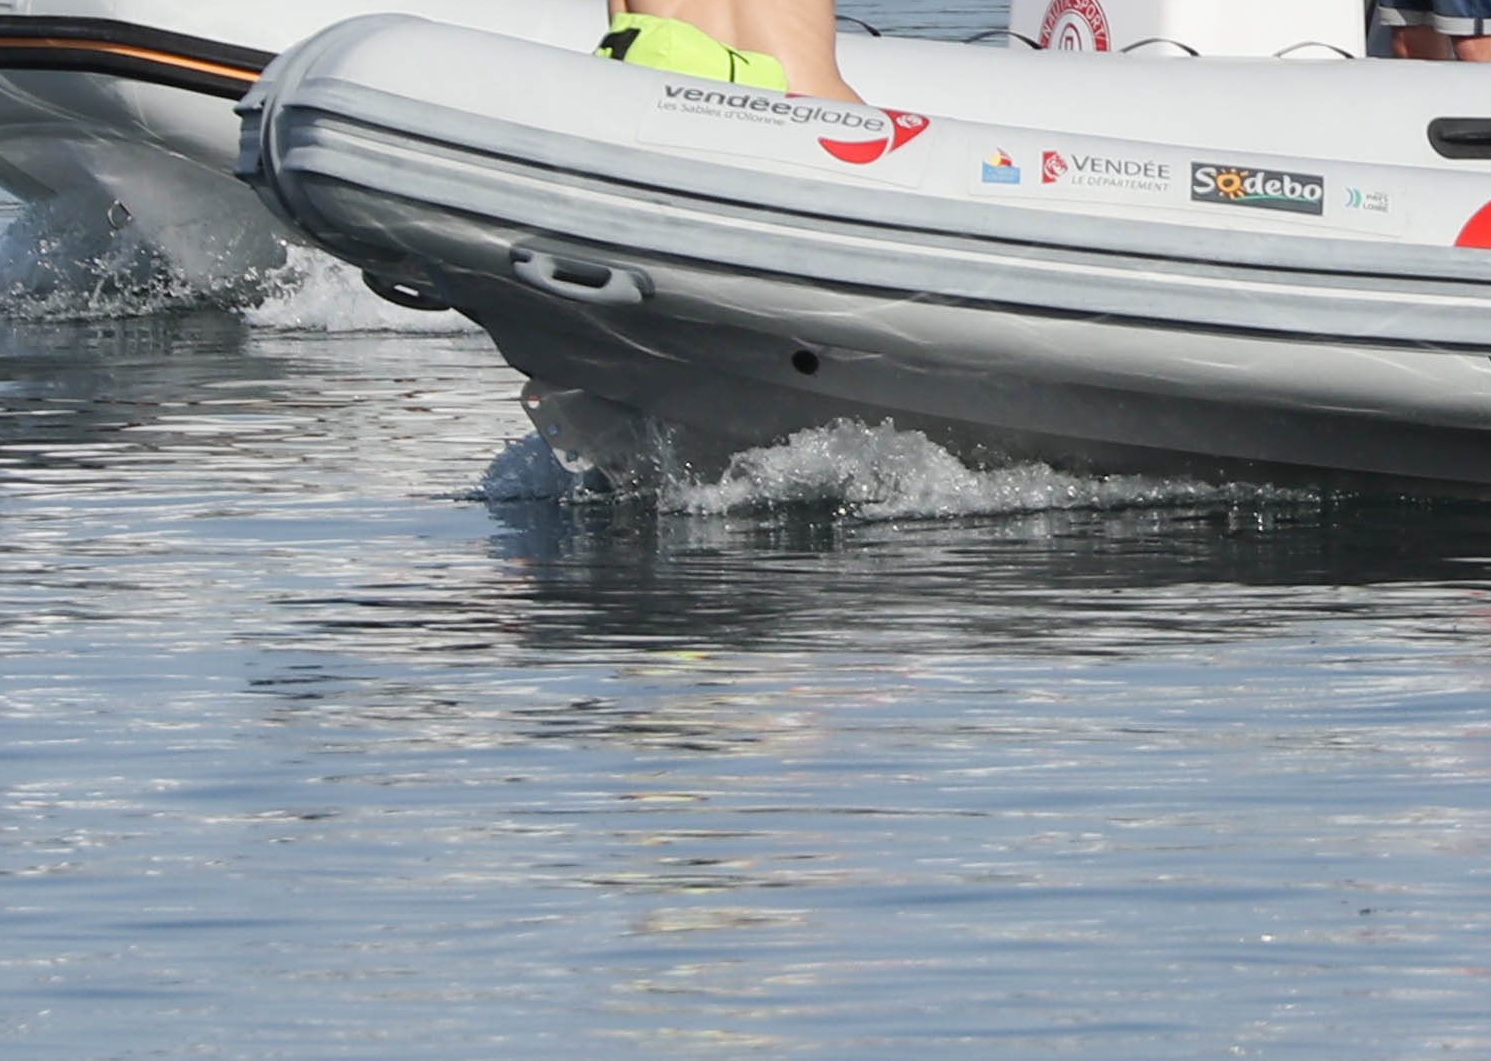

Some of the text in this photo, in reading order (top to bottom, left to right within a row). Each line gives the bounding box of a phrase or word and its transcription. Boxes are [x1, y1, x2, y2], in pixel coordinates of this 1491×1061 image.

[657, 100, 786, 127] Les Sables d'Olonne
[664, 84, 885, 133] vendéeglobe
[1071, 154, 1170, 179] VENDÉE
[1072, 175, 1170, 192] LE DÉPARTEMENT
[1193, 167, 1323, 200] Sodebo
